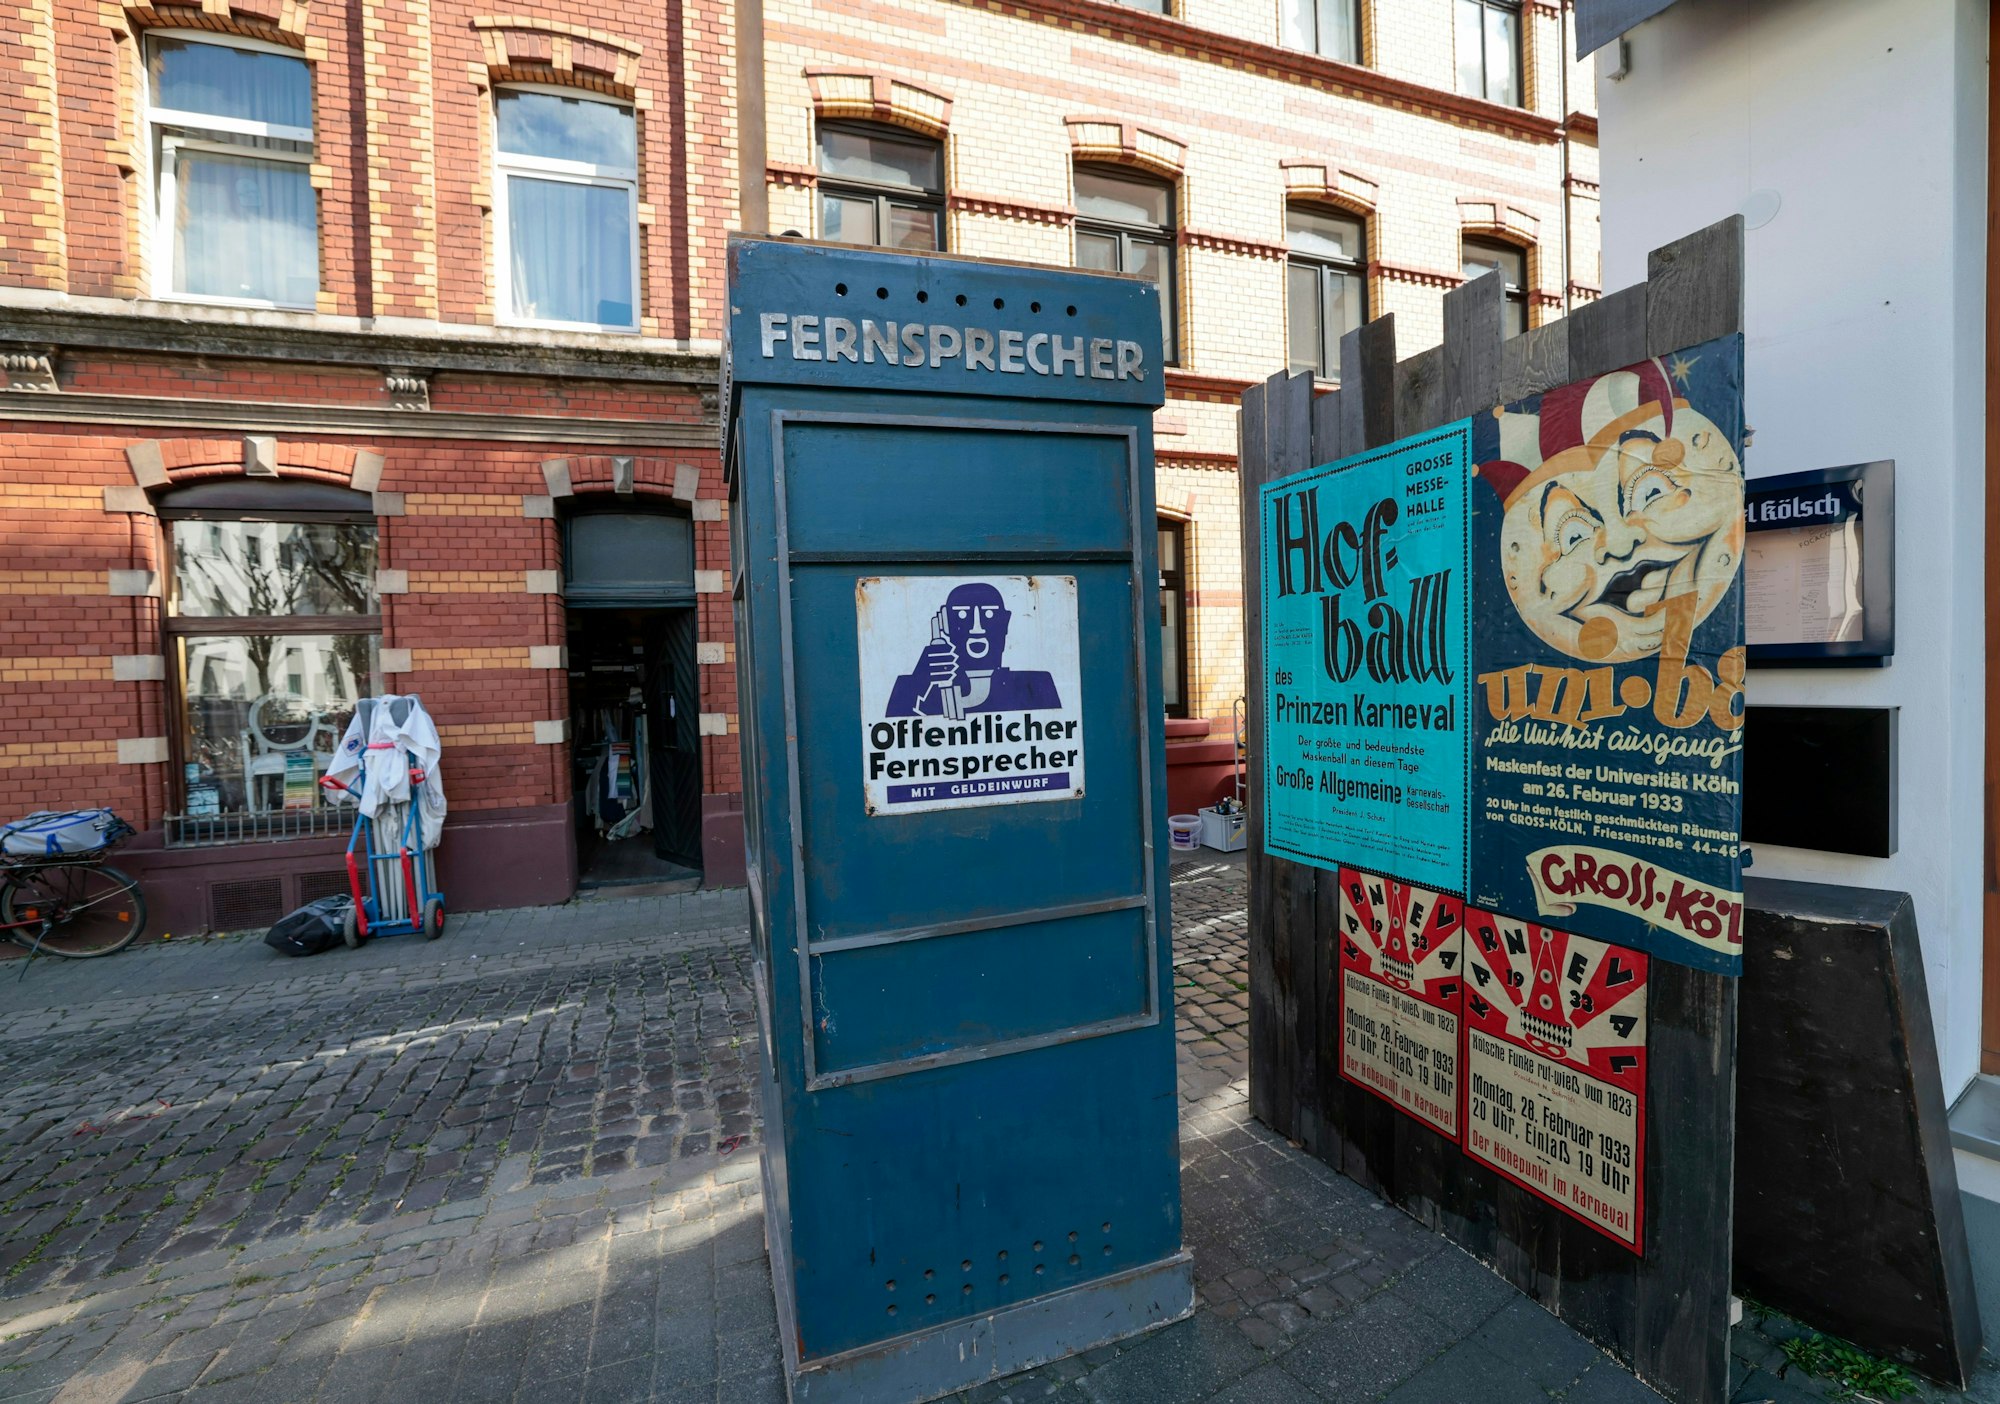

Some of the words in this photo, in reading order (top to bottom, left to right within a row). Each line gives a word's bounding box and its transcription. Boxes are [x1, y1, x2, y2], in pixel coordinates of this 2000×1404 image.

[759, 312, 1144, 382] FERNSPRECHER
[1406, 452, 1452, 476] GROSSE
[1406, 476, 1449, 497] MESSE-
[1407, 497, 1445, 518] HALLE
[1761, 492, 1840, 521] Kölsch
[1319, 569, 1455, 686] ball
[1275, 666, 1292, 686] des
[1276, 693, 1347, 726] Prinzen
[1353, 694, 1454, 731] Karneval
[868, 713, 1078, 750] Öffentlicher
[1298, 734, 1311, 746] Der
[1346, 738, 1360, 750] und
[1364, 738, 1425, 756] bedeutendste
[869, 746, 1078, 780] Fernsprecher
[1302, 750, 1347, 764] Maskenball
[1350, 758, 1360, 766] an
[1364, 755, 1395, 769] diesem
[1397, 758, 1419, 774] Tage
[1486, 756, 1562, 778] Maskenfest
[1565, 763, 1593, 780] der
[1595, 765, 1688, 790] Universität
[1692, 773, 1740, 795] Köln
[911, 786, 936, 798] MIT
[950, 777, 1049, 795] GELDEINWURF
[1276, 764, 1314, 791] Große
[1319, 770, 1402, 804] Allgemeine
[1406, 785, 1446, 799] Karnevals-
[1522, 782, 1544, 796] am
[1546, 781, 1570, 799] 26.
[1572, 784, 1636, 807] Februar
[1640, 792, 1684, 813] 1933
[1406, 797, 1450, 814] Gesellschaft
[1486, 797, 1500, 808] 20
[1501, 799, 1519, 811] Uhr
[1520, 801, 1531, 813] in
[1532, 803, 1552, 816] den
[1554, 805, 1593, 822] festlich
[1594, 813, 1679, 834] geschmückten
[1681, 822, 1739, 842] Räumen
[1485, 811, 1504, 822] von
[1509, 813, 1586, 836] GROSS-KÖLN,
[1593, 825, 1684, 850] Friesenstraße
[1691, 840, 1739, 858] 44-46
[1371, 917, 1383, 933] 19
[1411, 932, 1428, 951] 33
[1371, 984, 1390, 1005] Funke
[1422, 1008, 1435, 1026] vun
[1438, 1013, 1455, 1034] 1823
[1506, 968, 1525, 989] 19
[1569, 989, 1595, 1014] 33
[1346, 1006, 1378, 1039] Montag,
[1380, 1022, 1393, 1045] 28.
[1394, 1030, 1429, 1063] Februar
[1432, 1048, 1454, 1076] 1933
[1346, 1027, 1357, 1047] 20
[1383, 1045, 1413, 1078] Einlaß
[1418, 1063, 1429, 1086] 19
[1434, 1071, 1453, 1097] Uhr
[1472, 1033, 1505, 1062] Kölsche
[1508, 1048, 1534, 1074] Funke
[1537, 1062, 1580, 1095] rut-wieß
[1584, 1082, 1603, 1105] vun
[1607, 1091, 1632, 1117] 1823
[1346, 1054, 1358, 1072] Der
[1361, 1061, 1398, 1096] Höhepunkt
[1401, 1085, 1411, 1103] im
[1414, 1090, 1453, 1127] Karneval
[1472, 1072, 1516, 1114] Montag,
[1521, 1096, 1538, 1124] 28.
[1543, 1105, 1594, 1149] Februar
[1599, 1133, 1630, 1169] 1933
[1472, 1098, 1486, 1122] 20
[1525, 1122, 1570, 1165] Einlaß
[1578, 1150, 1593, 1177] 19
[1601, 1160, 1630, 1195] Uhr
[1472, 1129, 1489, 1153] Der
[1493, 1141, 1548, 1186] Höhepunkt
[1553, 1173, 1567, 1197] im
[1572, 1183, 1629, 1232] Karneval
